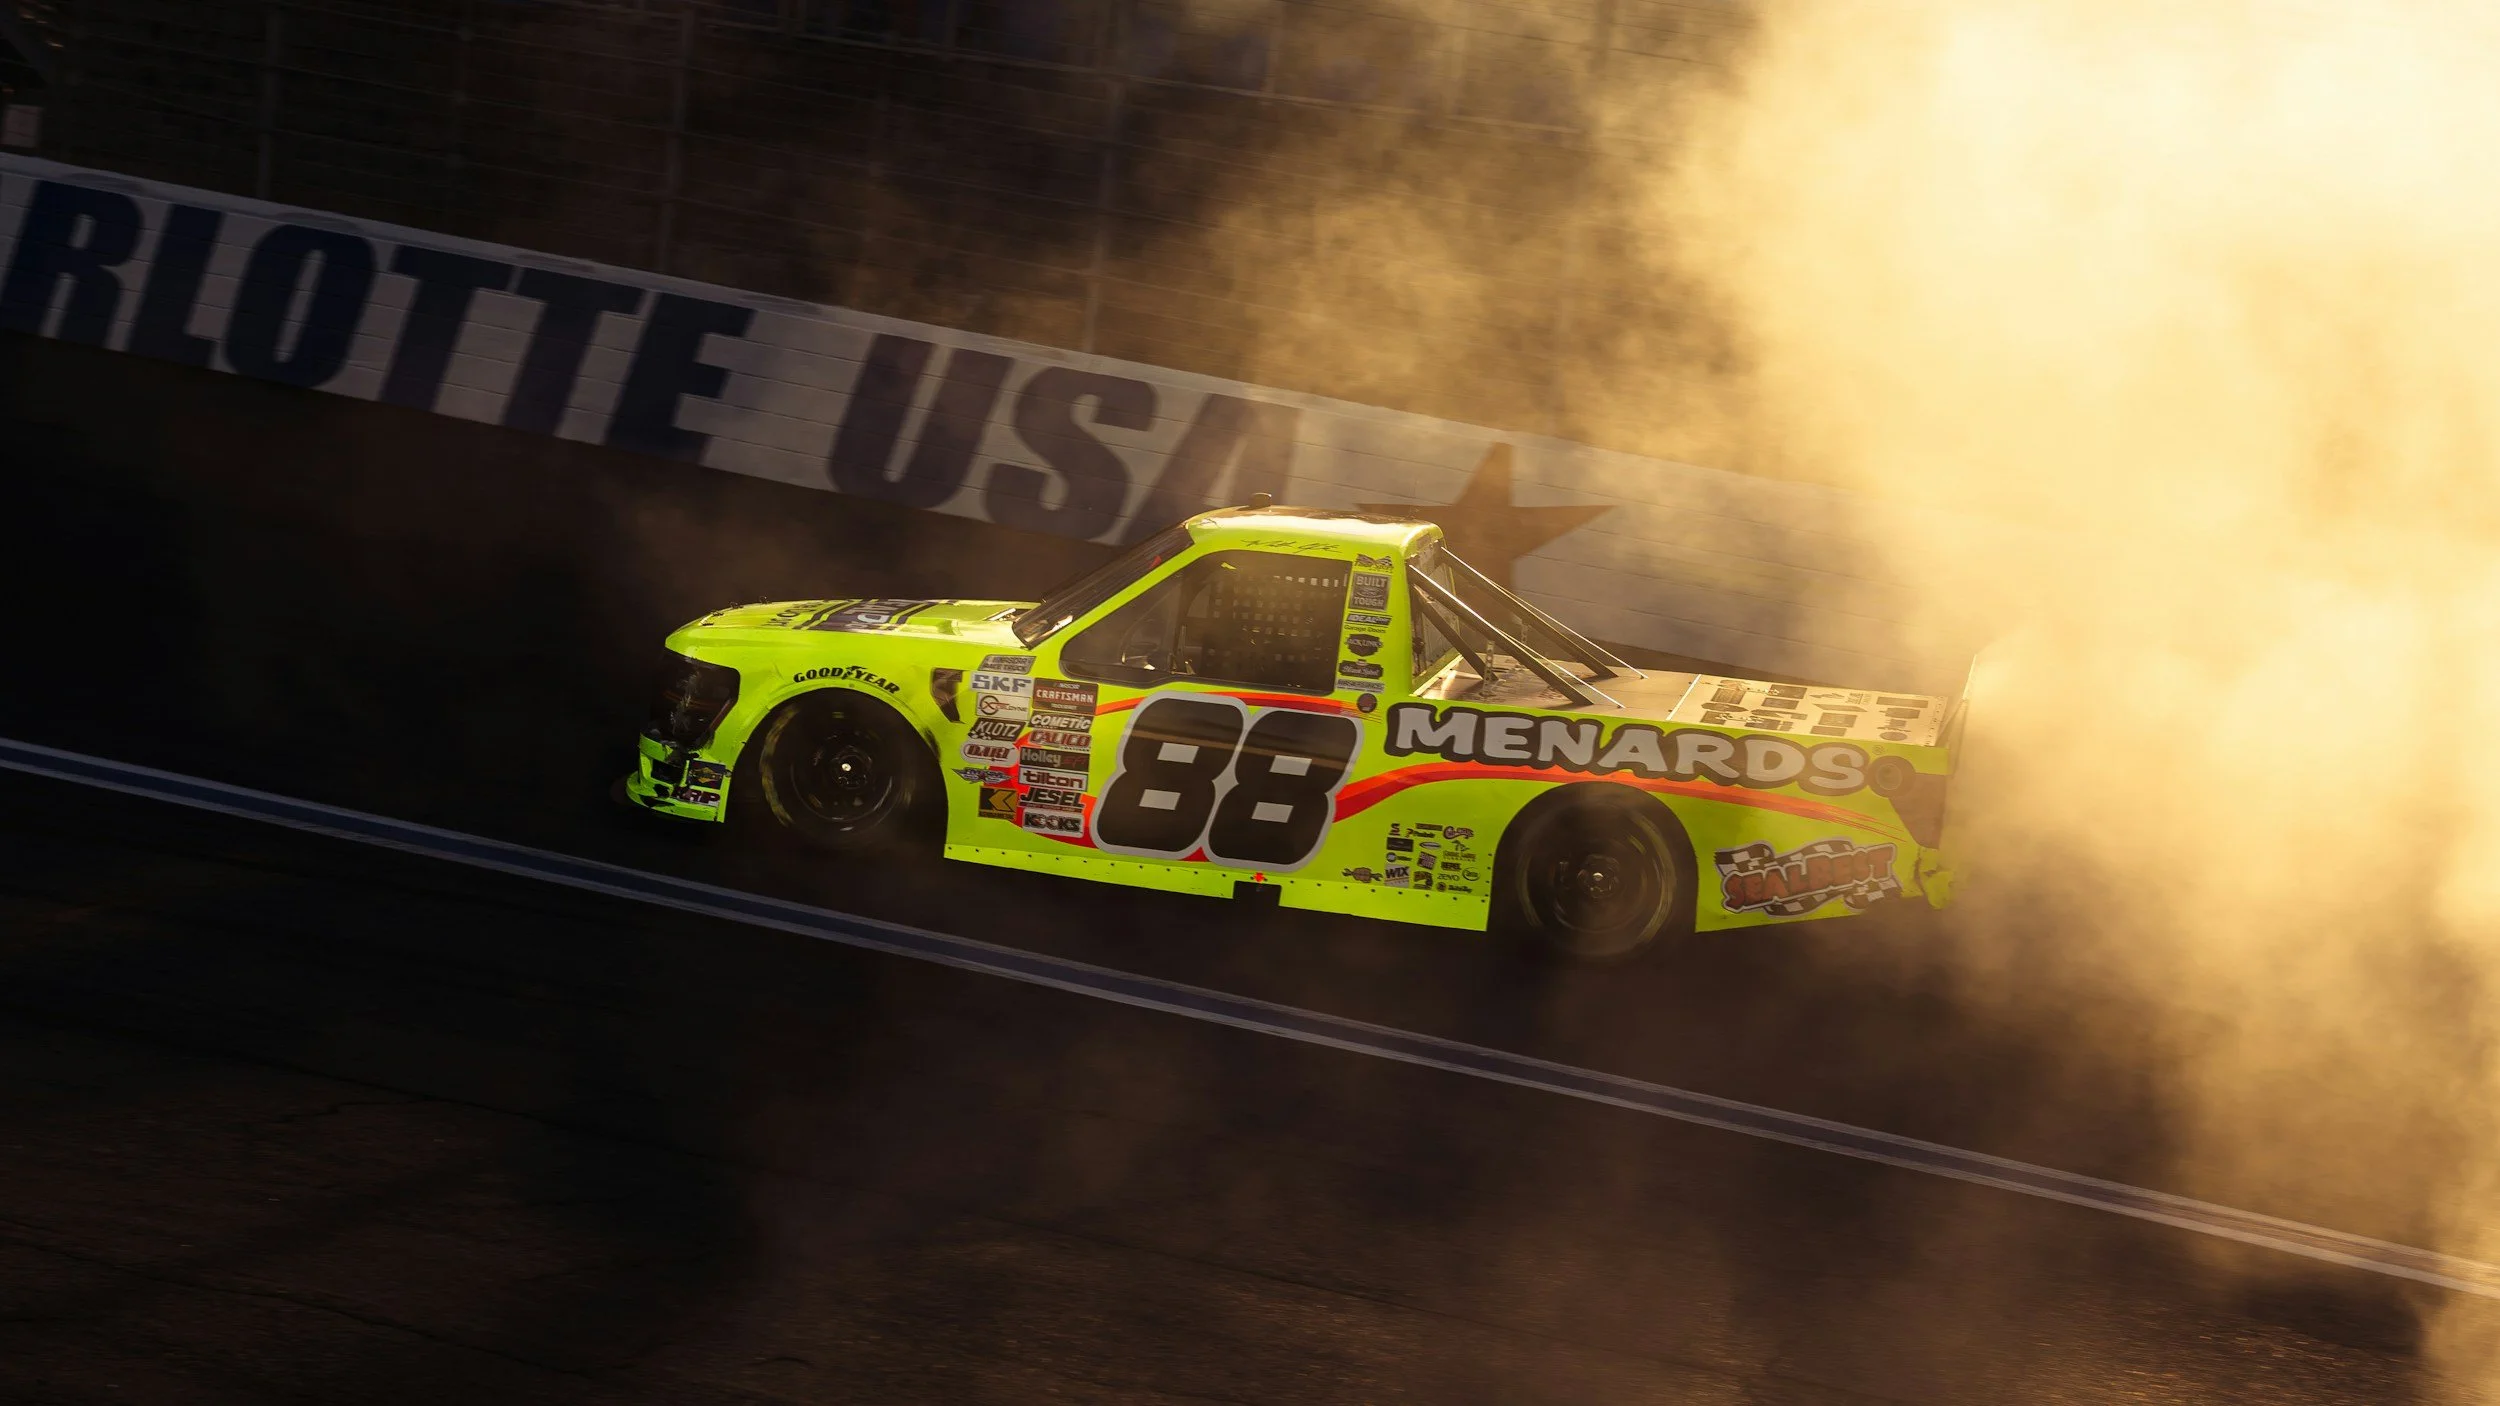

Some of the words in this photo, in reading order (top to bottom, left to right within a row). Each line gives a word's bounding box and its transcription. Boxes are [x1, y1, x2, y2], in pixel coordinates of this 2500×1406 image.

[826, 333, 1298, 550] USA
[1356, 575, 1387, 588] BUILT
[1353, 596, 1385, 608] TOUGH
[793, 665, 901, 694] GOODYEAR
[972, 674, 1032, 693] SKF
[1036, 684, 1095, 704] CRAFTSMAN
[976, 721, 1021, 737] KLOTZ
[1030, 731, 1091, 748] CALICO
[1390, 703, 1867, 793] MENARDS
[1021, 747, 1062, 767] Holley
[1023, 770, 1084, 788] tilton
[1094, 694, 1361, 869] 88
[1019, 787, 1085, 808] JESEL
[1385, 866, 1410, 879] WIX
